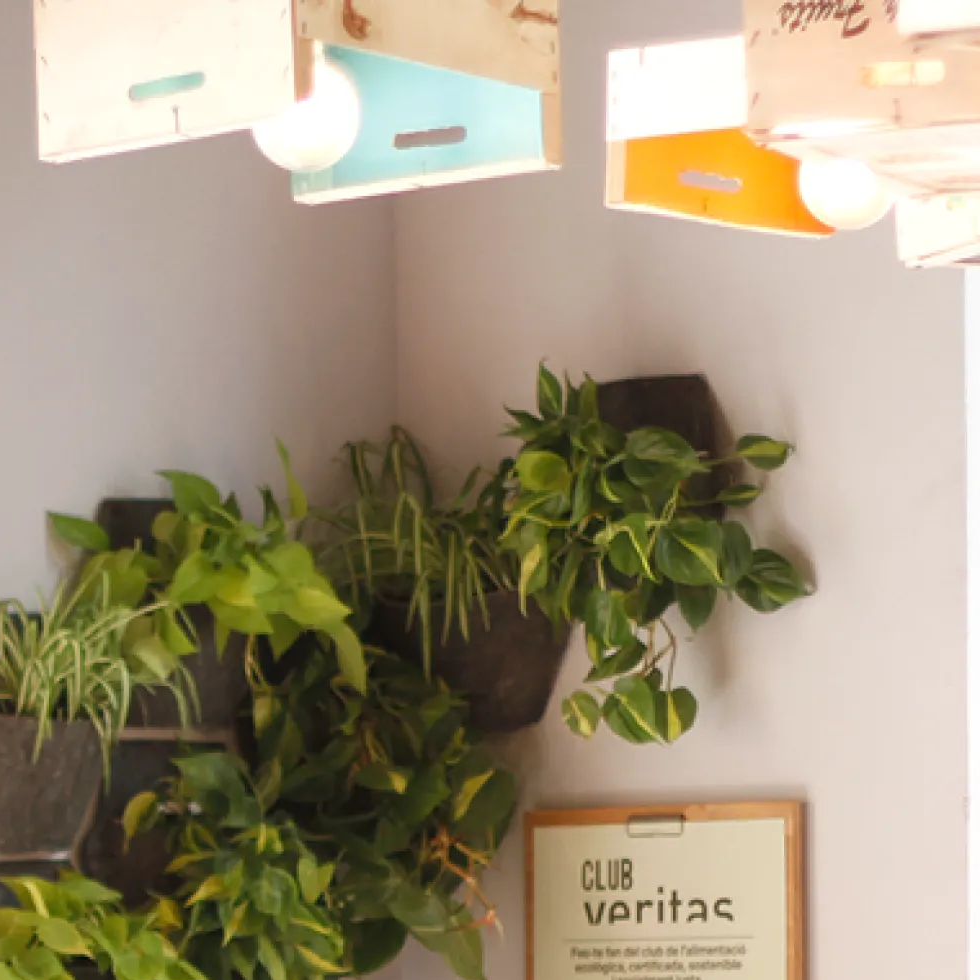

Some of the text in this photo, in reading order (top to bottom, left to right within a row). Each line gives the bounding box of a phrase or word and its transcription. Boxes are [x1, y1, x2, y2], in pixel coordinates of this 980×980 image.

[582, 858, 633, 891] CLUB
[584, 886, 735, 926] veritas
[624, 946, 640, 958] del
[642, 945, 663, 957] club
[666, 945, 679, 957] de
[688, 959, 743, 972] sostenible
